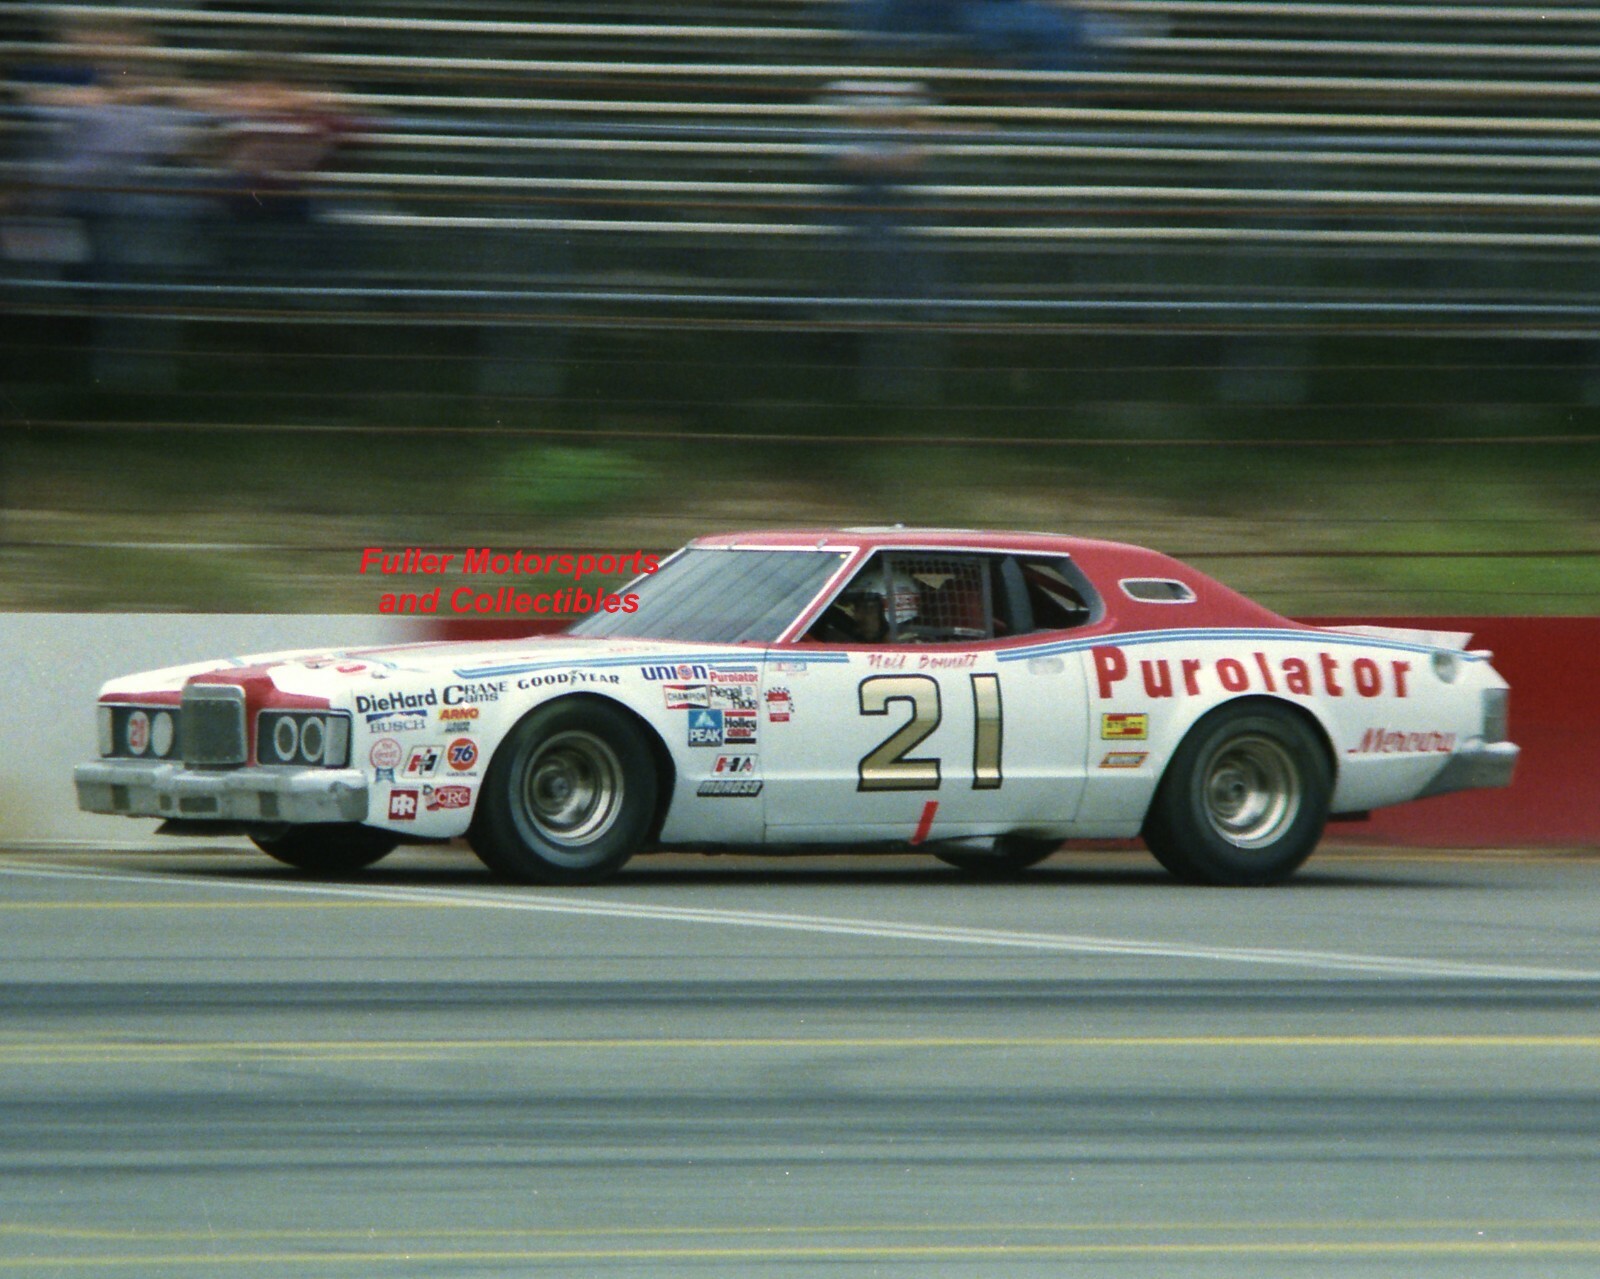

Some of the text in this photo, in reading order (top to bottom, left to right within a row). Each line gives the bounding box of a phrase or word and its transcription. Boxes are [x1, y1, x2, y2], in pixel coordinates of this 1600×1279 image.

[709, 671, 759, 682] Purolator
[1092, 645, 1411, 699] Purolator
[667, 692, 708, 702] CHAMPION
[710, 683, 743, 700] Regal
[356, 688, 438, 713] DieHard
[732, 697, 759, 710] Ride
[439, 707, 479, 721] ARNO
[369, 718, 426, 734] BUSCH
[724, 717, 757, 732] Holley
[690, 729, 722, 743] PEAK
[856, 672, 1003, 793] 21
[453, 745, 473, 762] 76
[436, 792, 468, 804] CRC
